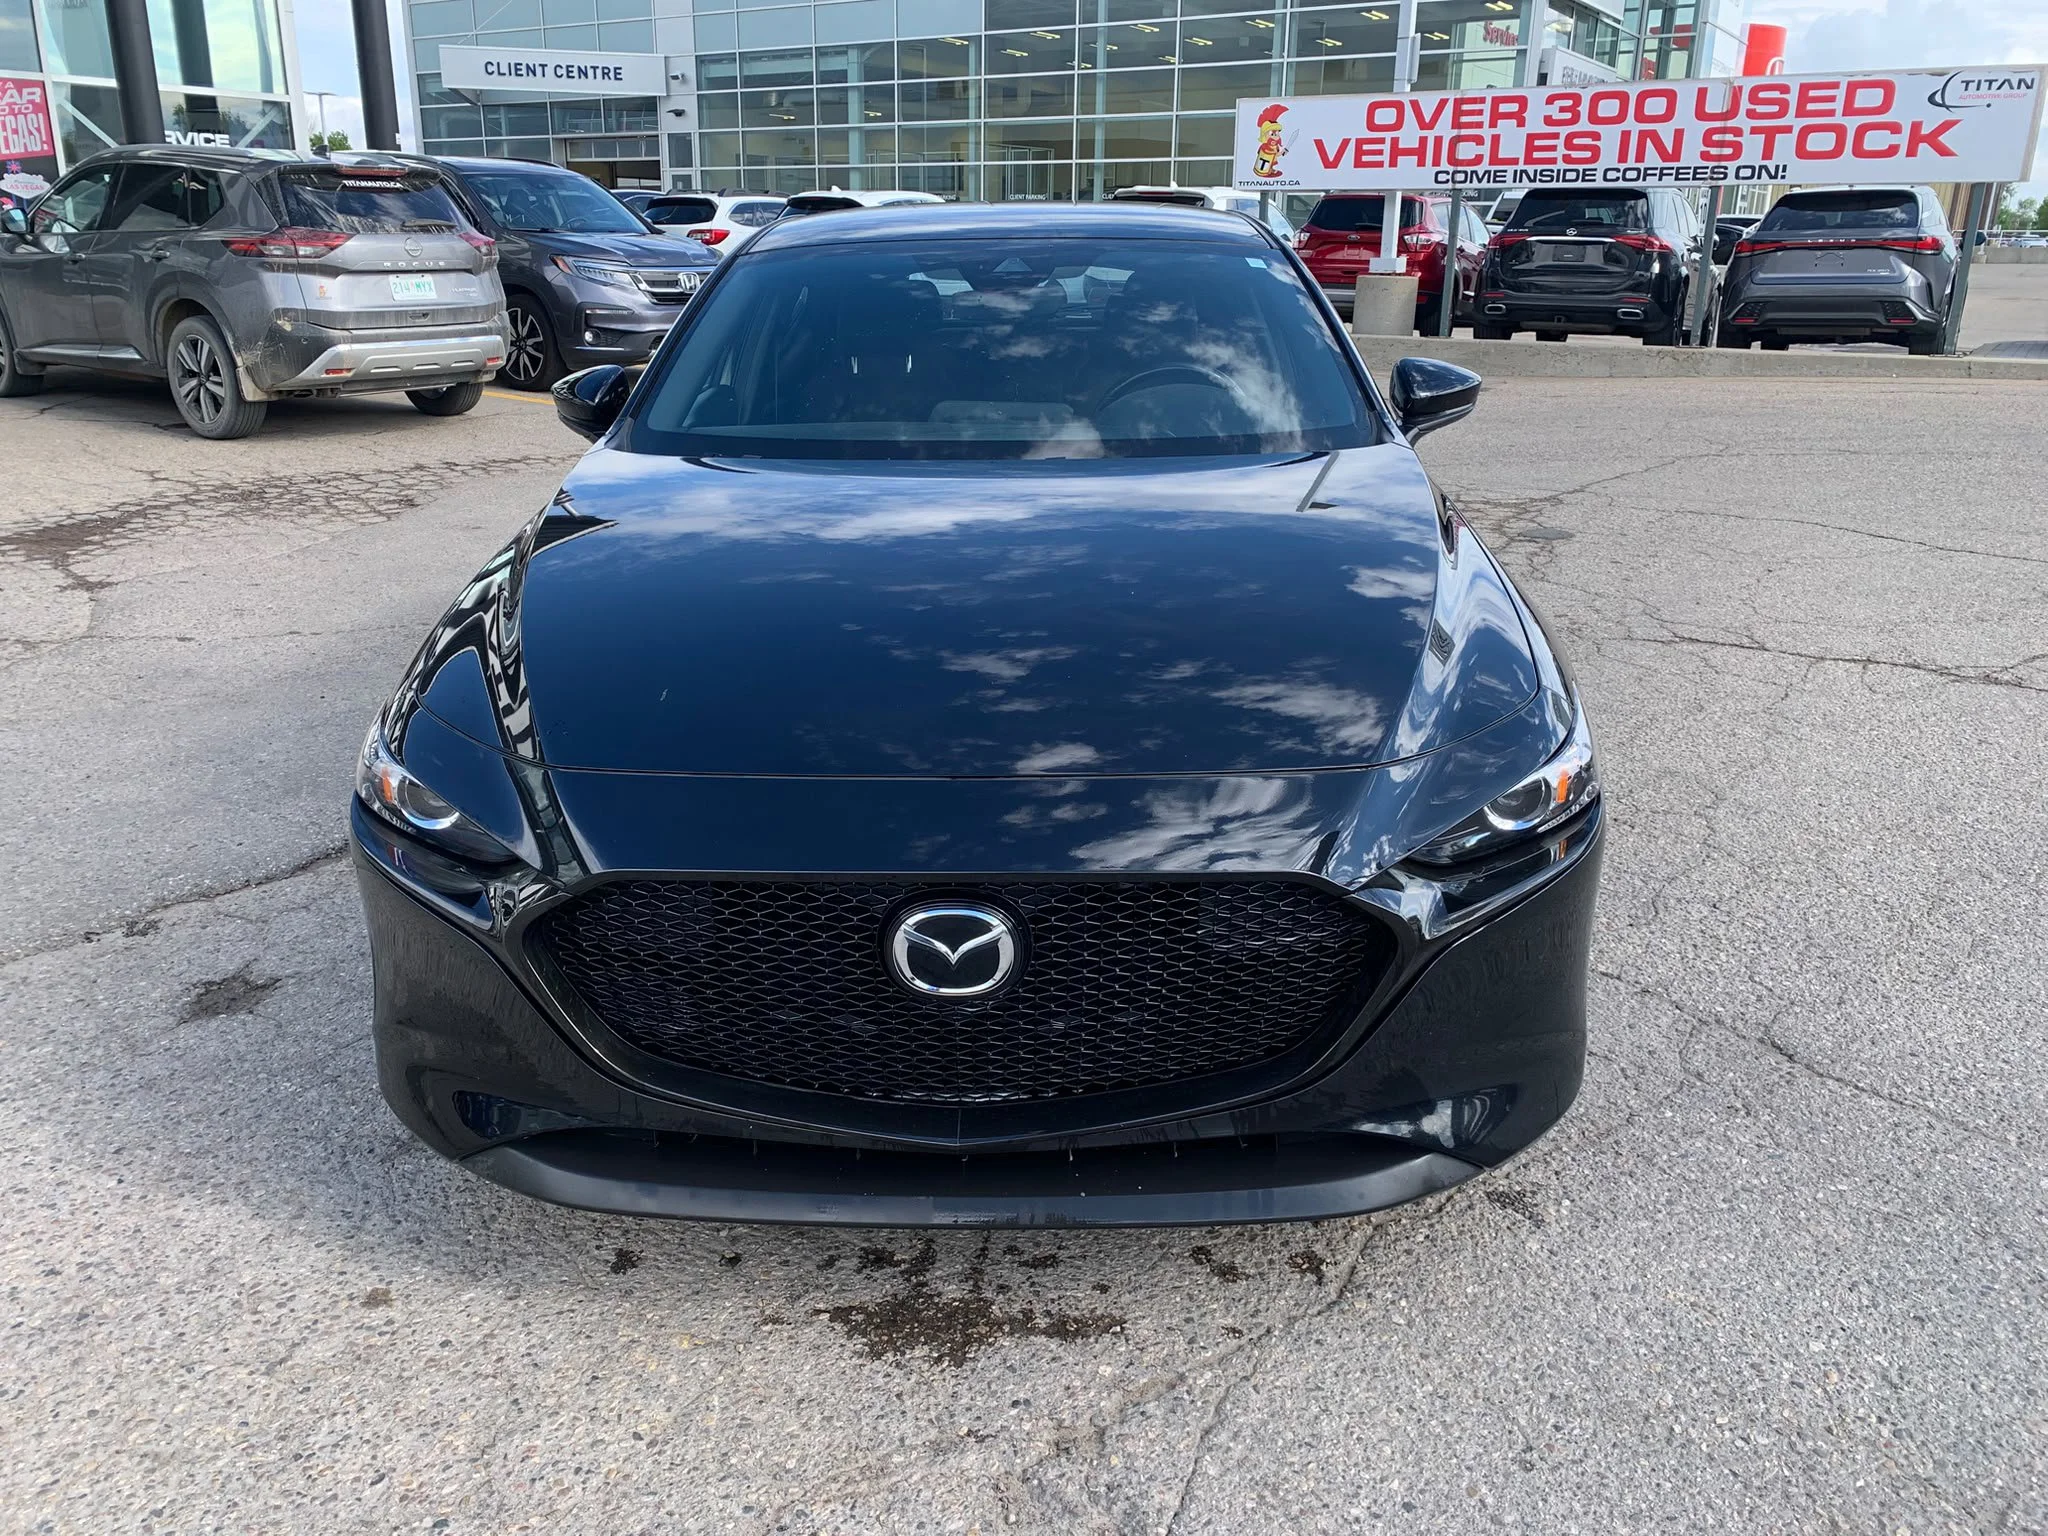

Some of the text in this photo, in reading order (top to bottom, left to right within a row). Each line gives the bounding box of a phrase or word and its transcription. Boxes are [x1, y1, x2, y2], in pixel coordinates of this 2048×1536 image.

[484, 61, 623, 81] CLIENT CENTRE
[1960, 78, 2035, 91] TITAN
[12, 103, 33, 113] TO
[1365, 79, 1896, 133] OVER 300 USED
[1314, 119, 1964, 169] VEHICLES IN STOCK
[1434, 163, 1788, 185] COME INSIDE COFFEES ON!
[1238, 179, 1301, 187] TITANAUTO.CA
[392, 282, 411, 294] 214
